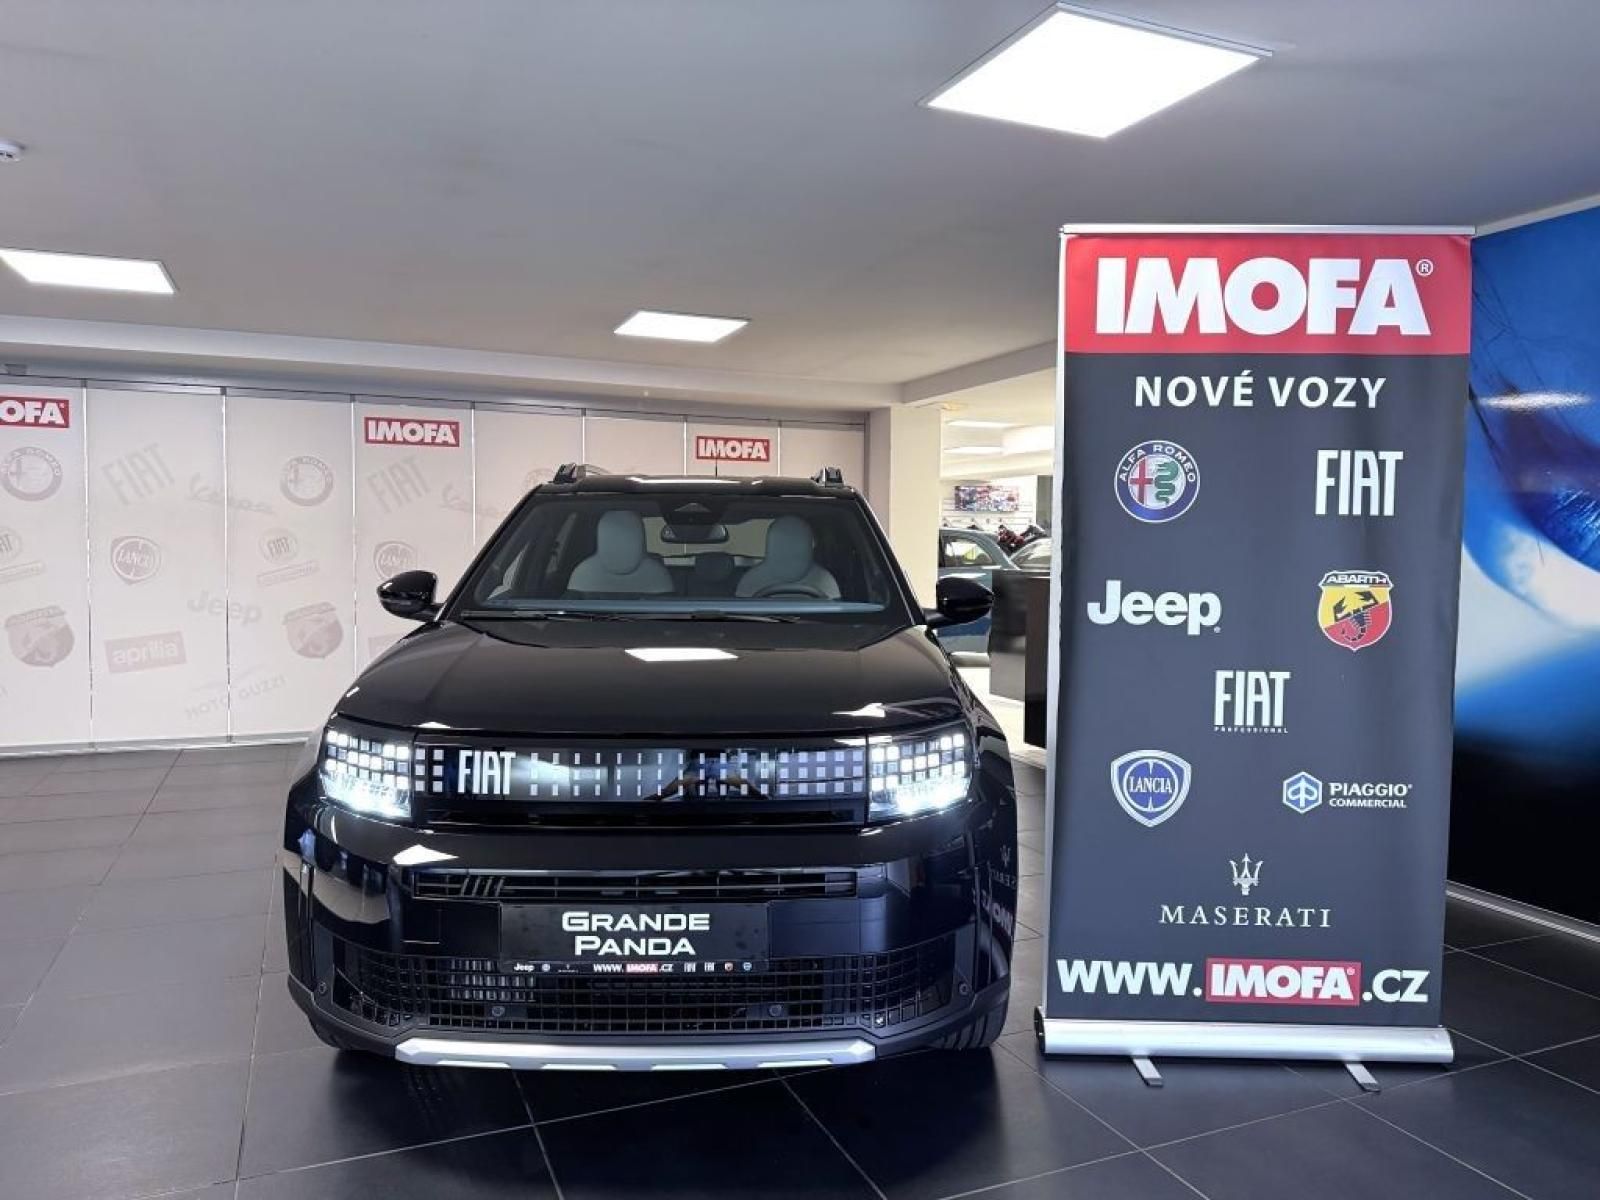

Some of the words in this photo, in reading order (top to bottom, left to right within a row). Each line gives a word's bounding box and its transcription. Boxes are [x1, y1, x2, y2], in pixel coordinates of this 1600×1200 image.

[1135, 370, 1254, 407] NOVÉ
[1269, 376, 1387, 409] VOZY
[368, 420, 457, 444] IMOFA
[698, 439, 767, 459] IMOFA
[1119, 449, 1147, 482] ALFA
[1153, 444, 1196, 482] ROMEO
[1315, 449, 1404, 517] FIAT
[1326, 574, 1388, 585] ABARTH
[1087, 579, 1222, 635] Jeep
[111, 640, 179, 667] aprilia
[1214, 669, 1292, 727] FIAT
[457, 749, 517, 795] FIAT
[1129, 775, 1173, 793] LANCIA
[1328, 782, 1409, 797] PIAGGIO
[1329, 798, 1407, 809] COMMERCIAL
[562, 911, 710, 932] GRANDE
[1158, 904, 1332, 928] MASERATI
[574, 935, 696, 956] PANDA
